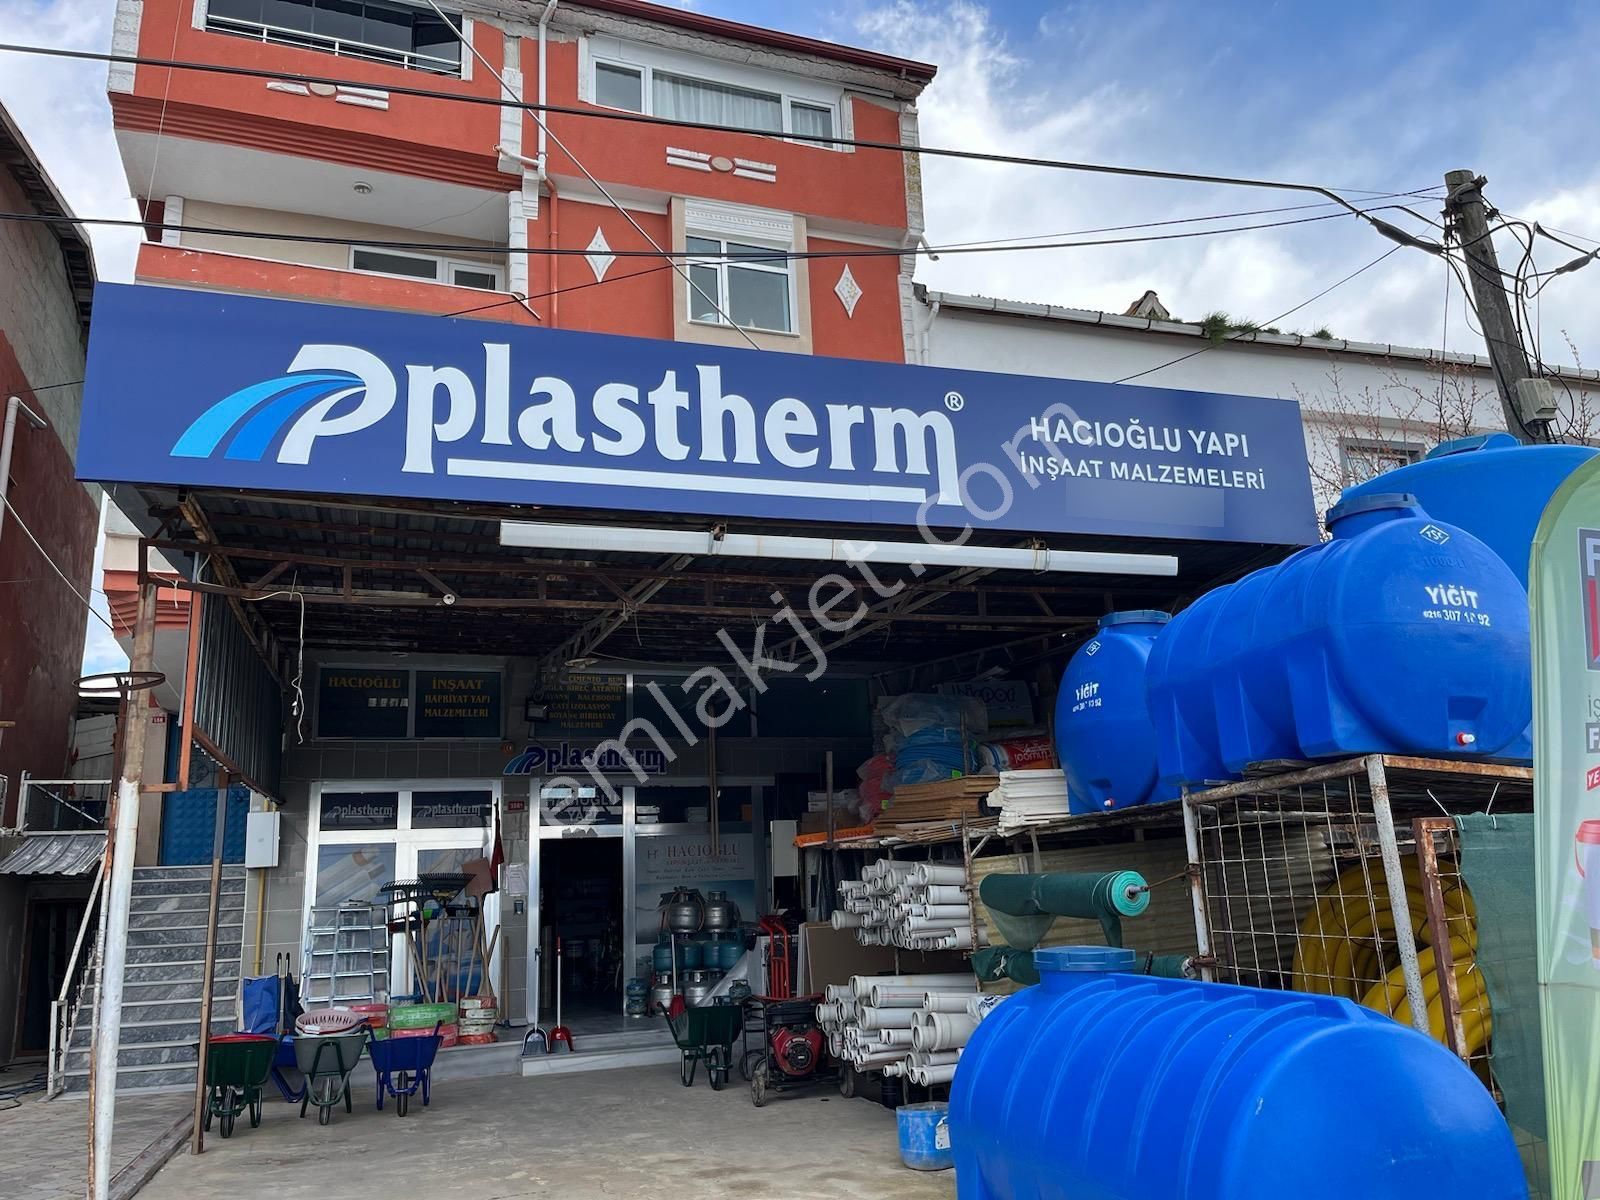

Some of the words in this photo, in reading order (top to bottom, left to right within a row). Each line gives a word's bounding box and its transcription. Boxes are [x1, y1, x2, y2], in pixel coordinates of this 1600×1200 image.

[401, 342, 963, 497] plastherm
[1029, 416, 1182, 453] HACIOĞLU
[1187, 429, 1250, 458] YAPI
[1020, 451, 1104, 481] İNŞAAT
[1110, 461, 1266, 490] MALZEMELERİ
[1424, 583, 1479, 609] YİĞİT
[1442, 609, 1461, 622] 307
[1477, 613, 1491, 627] 92
[327, 675, 401, 689] HACIOĞLU
[545, 741, 668, 775] plasthrm
[340, 804, 393, 818] plastherm
[667, 843, 739, 858] HACIOLU
